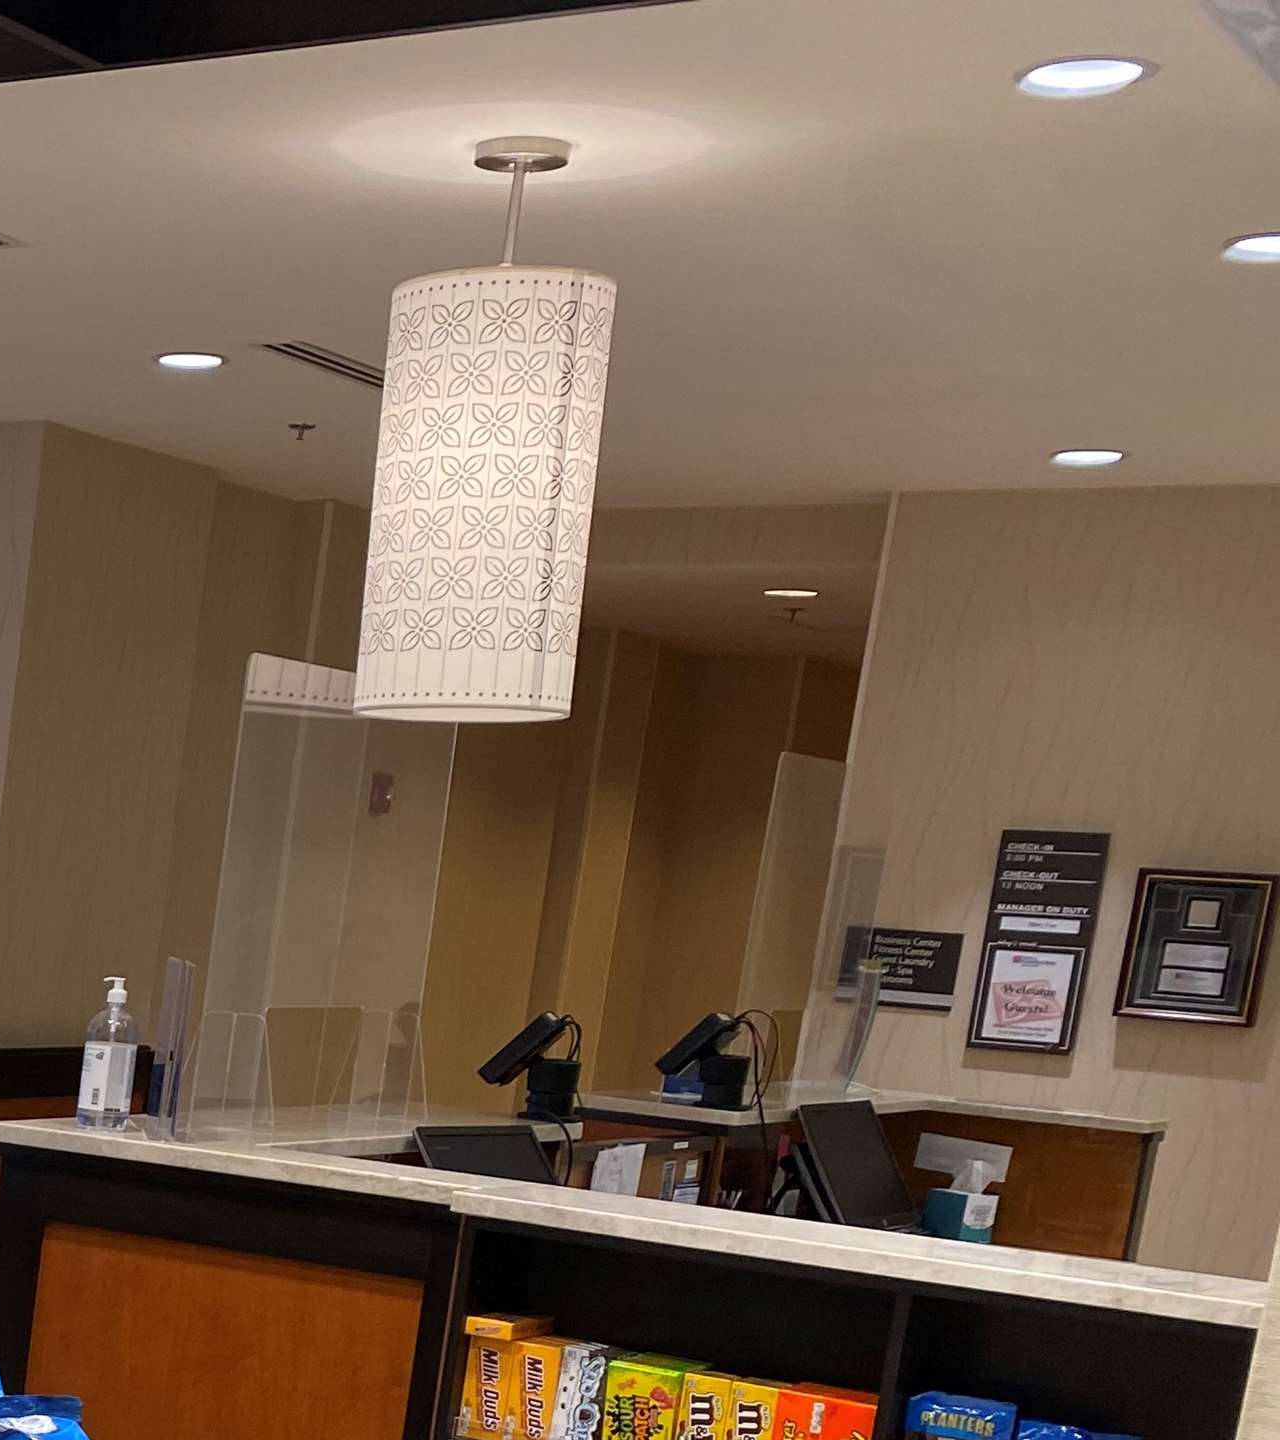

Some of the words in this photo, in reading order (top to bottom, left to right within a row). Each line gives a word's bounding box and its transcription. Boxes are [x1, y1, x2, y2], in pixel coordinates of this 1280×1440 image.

[1002, 870, 1059, 880] CHECK-OUT
[996, 904, 1044, 914] MANAGER
[1062, 907, 1089, 916] DUTY
[913, 937, 942, 948] Center
[1002, 983, 1057, 999] Welcome
[1004, 1001, 1050, 1016] Guests!
[481, 1347, 500, 1386] Milk
[525, 1354, 544, 1394] Milk
[483, 1387, 501, 1432] Duds
[526, 1396, 545, 1440] Duds
[920, 1410, 995, 1437] PLANTERS
